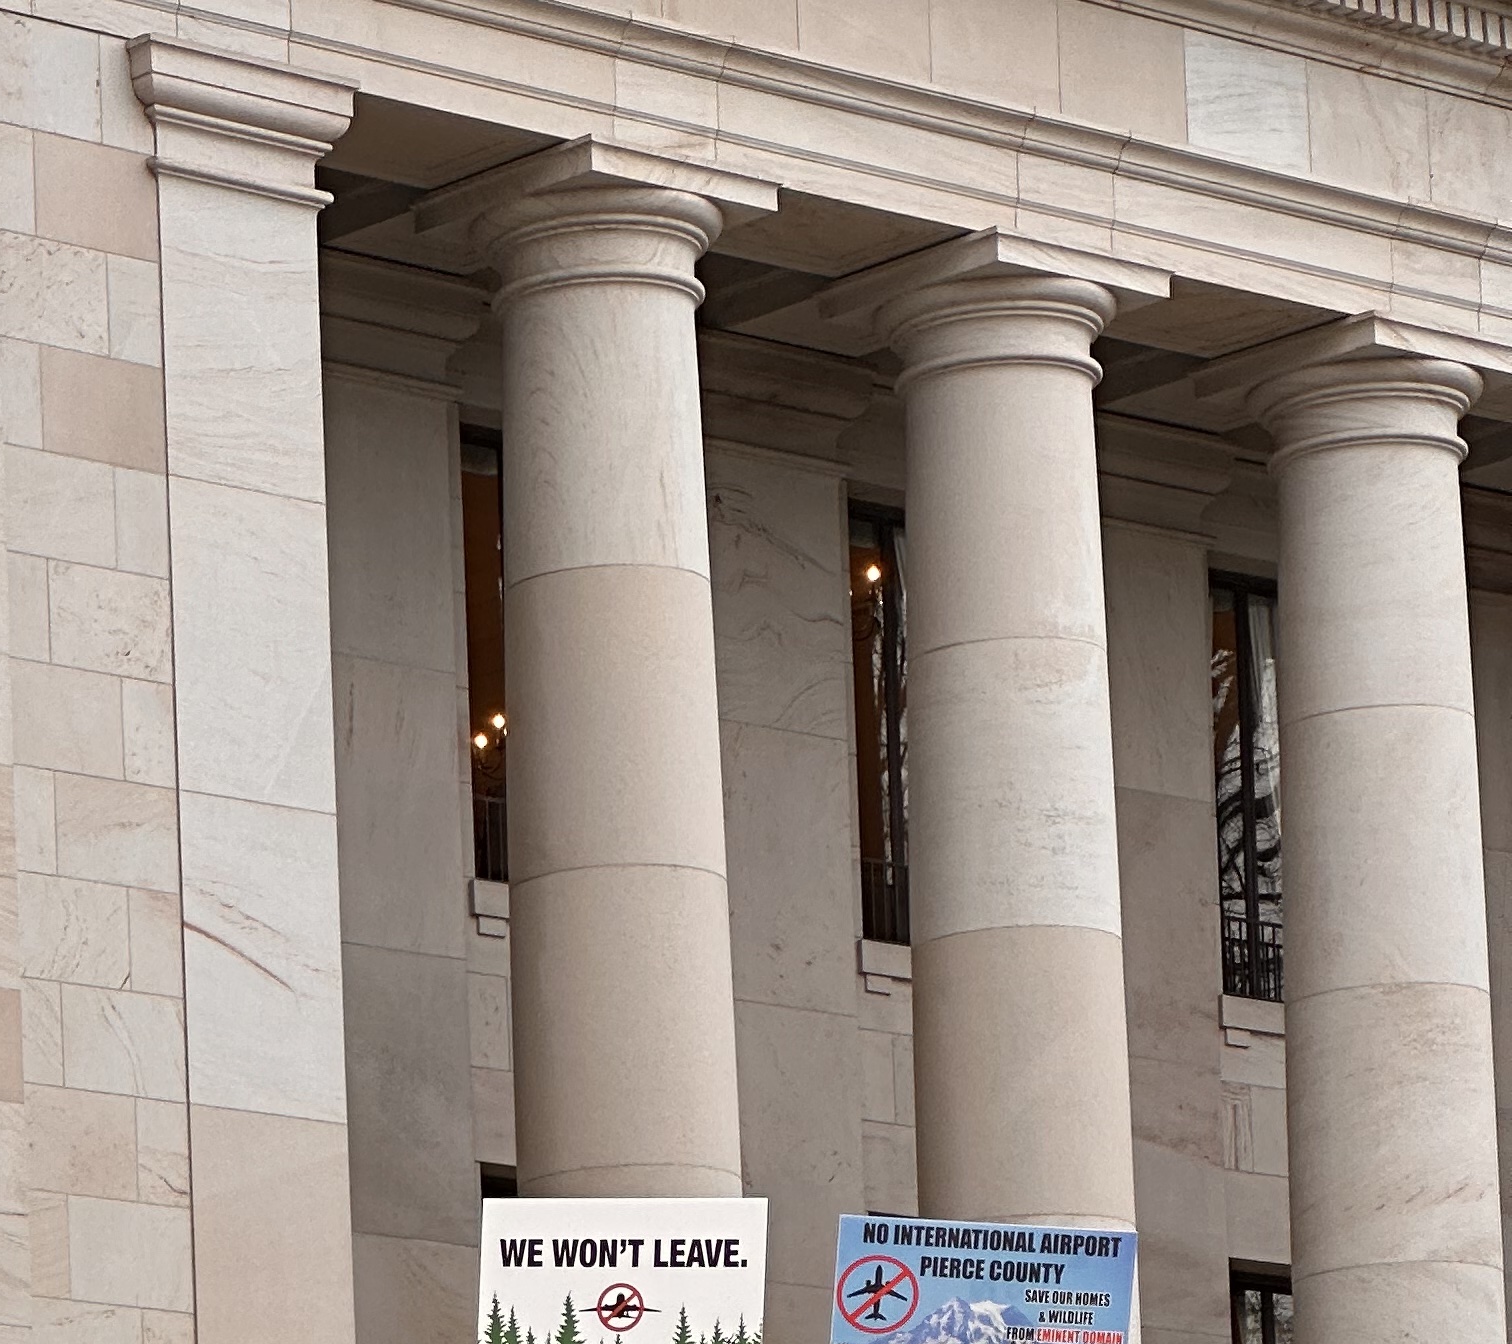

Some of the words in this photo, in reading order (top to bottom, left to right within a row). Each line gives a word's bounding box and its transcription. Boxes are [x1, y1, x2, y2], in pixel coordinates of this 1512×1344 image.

[863, 1223, 888, 1244] NO
[894, 1225, 1035, 1253] INTERNATIONAL
[1040, 1233, 1122, 1258] AIRPORT
[500, 1239, 543, 1268] WE
[552, 1239, 644, 1268] WON'T
[653, 1239, 748, 1268] LEAVE.
[920, 1256, 984, 1280] PIERCE
[989, 1260, 1065, 1284] COUNTY
[1025, 1289, 1050, 1304] SAVE
[1052, 1291, 1072, 1305] OUR
[1075, 1292, 1110, 1307] HOMES
[1039, 1311, 1046, 1323] &
[1048, 1310, 1094, 1325] WILDLIFE
[1006, 1327, 1034, 1341] FROM
[1037, 1328, 1081, 1344] EMINENT
